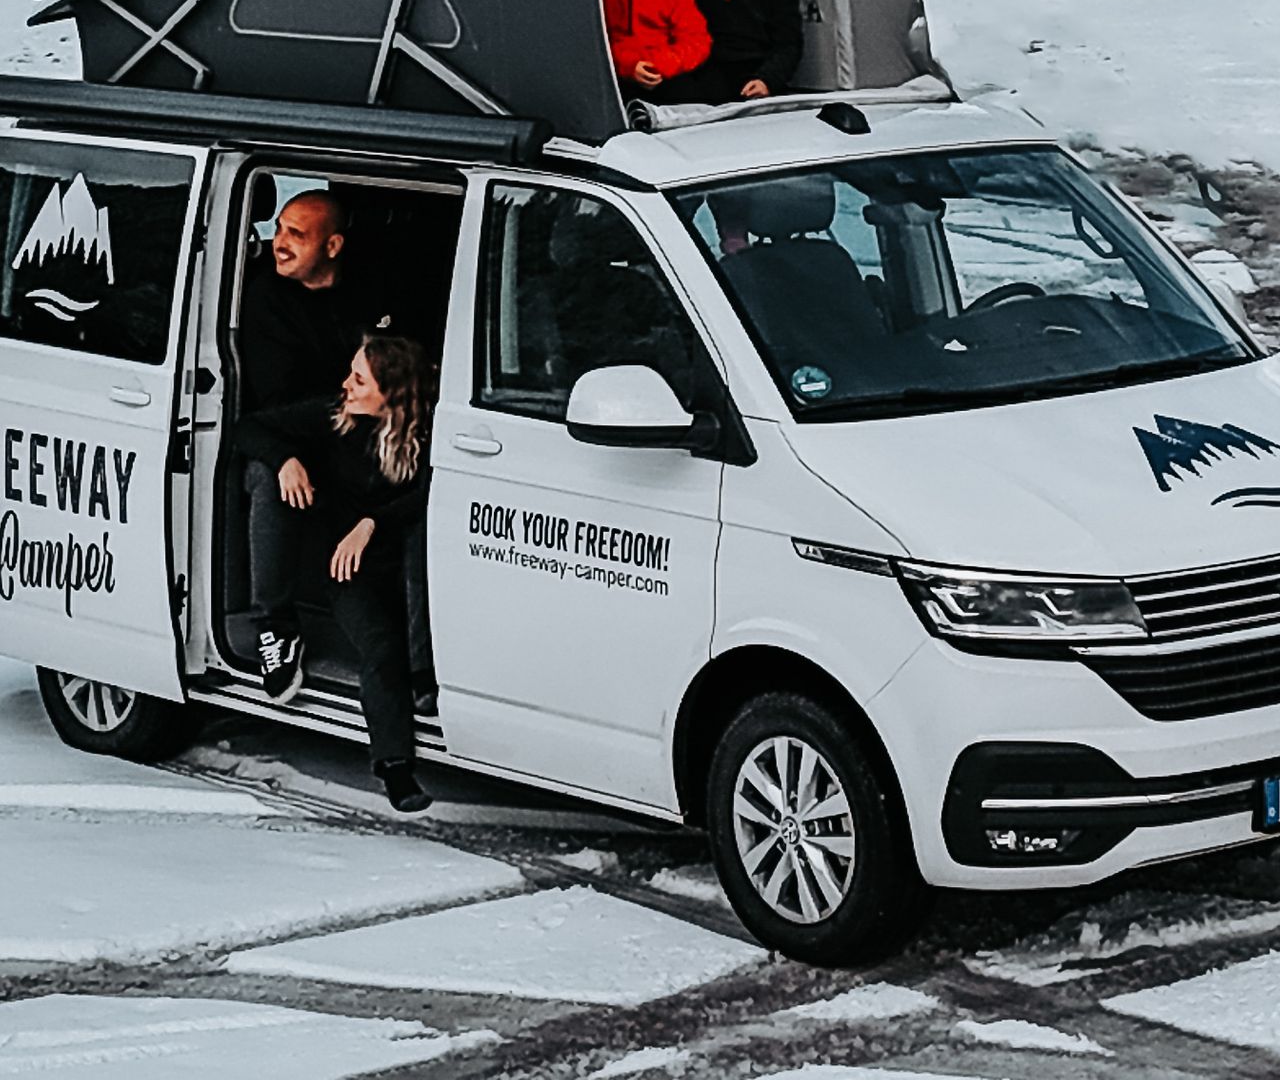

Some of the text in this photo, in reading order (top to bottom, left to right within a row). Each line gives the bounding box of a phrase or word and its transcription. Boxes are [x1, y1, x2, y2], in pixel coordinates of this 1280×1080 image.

[469, 501, 671, 572] BOOK YOUR FREEDOM!
[468, 542, 669, 596] www.freeway-camper.com
